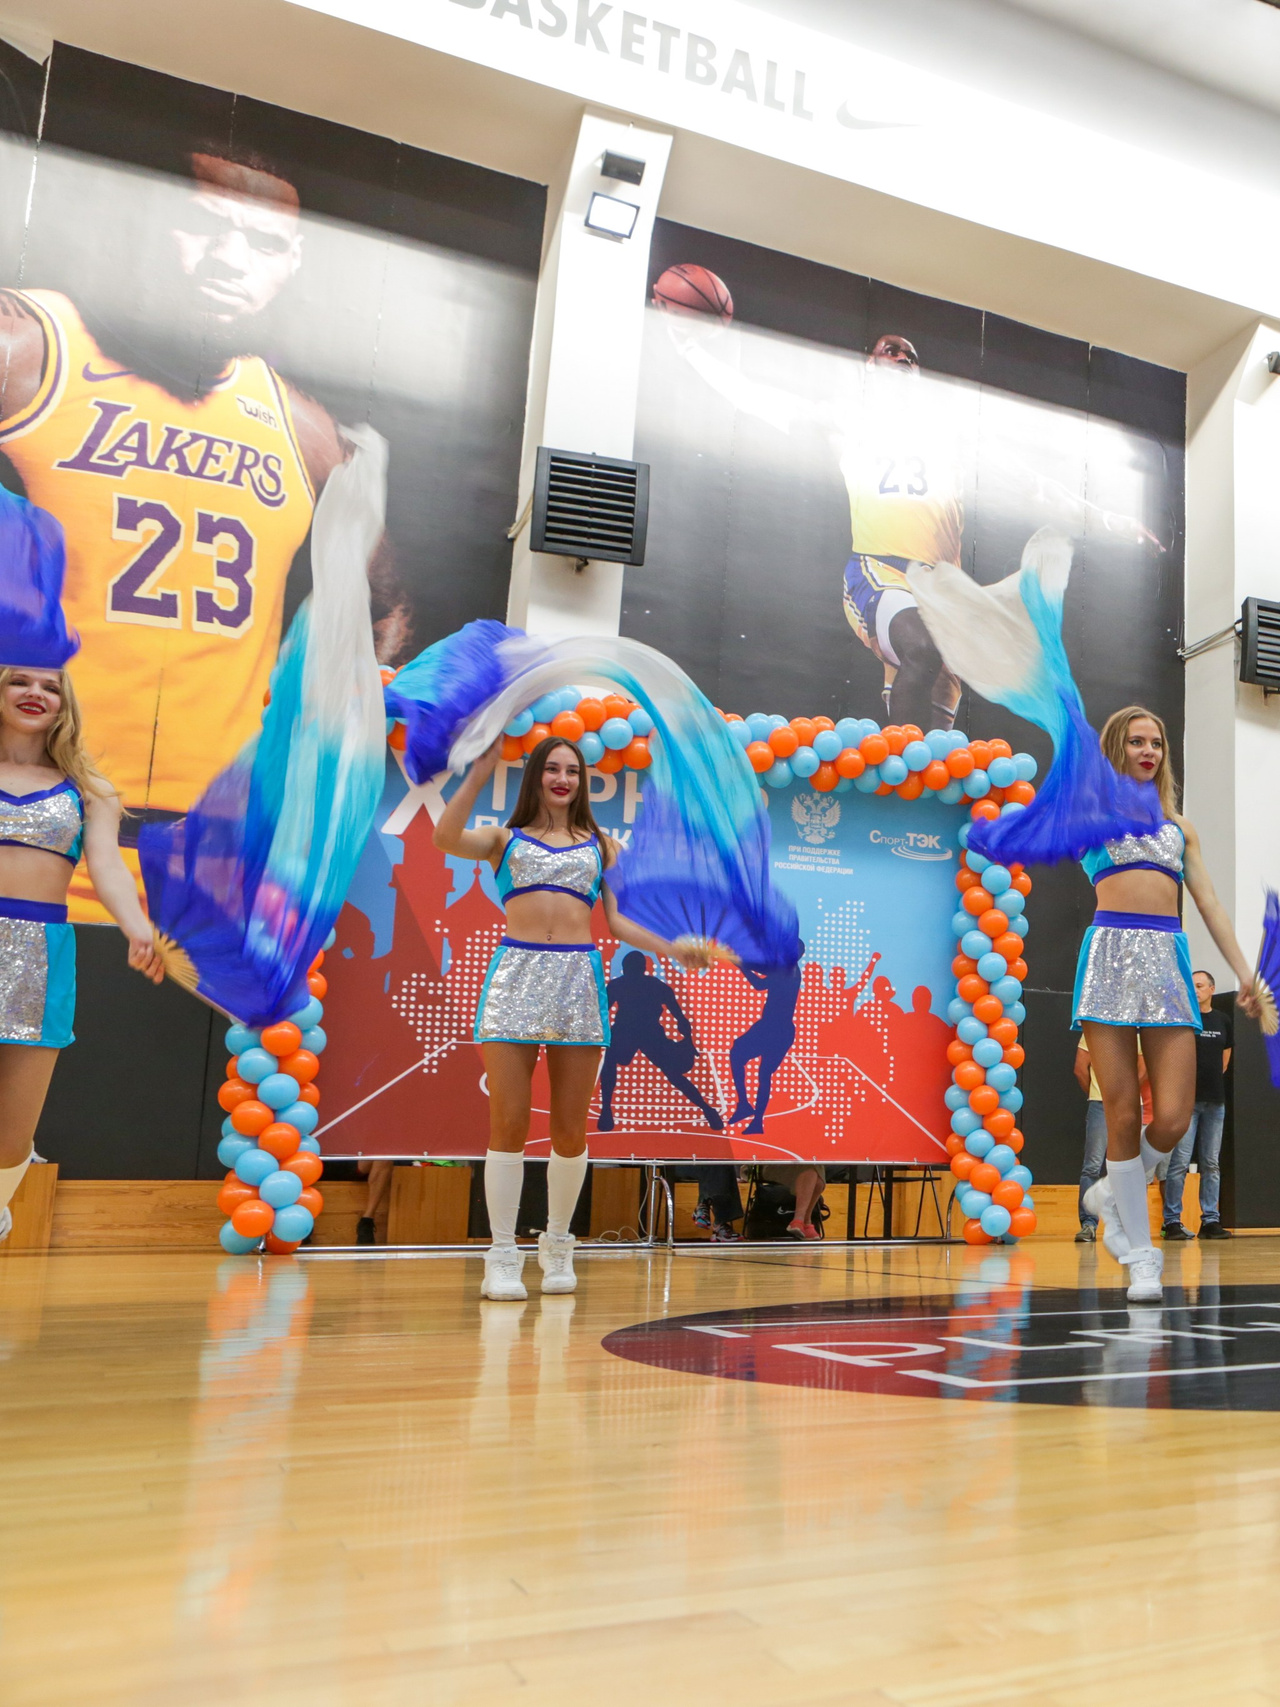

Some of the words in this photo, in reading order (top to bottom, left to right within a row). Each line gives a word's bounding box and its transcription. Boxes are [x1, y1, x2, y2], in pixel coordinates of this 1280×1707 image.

[235, 395, 278, 429] wish
[53, 398, 287, 511] LAKERS
[875, 455, 929, 496] 23
[106, 492, 257, 639] 23
[788, 845, 801, 853] ПРИ
[802, 847, 841, 856] ПОДДЕРЖКЕ
[788, 854, 840, 865] ПРАВИТЕЛЬСТВА
[774, 861, 815, 872] РОССИЙСКОЙ
[816, 864, 854, 875] ФЕДЕРАЦИИ
